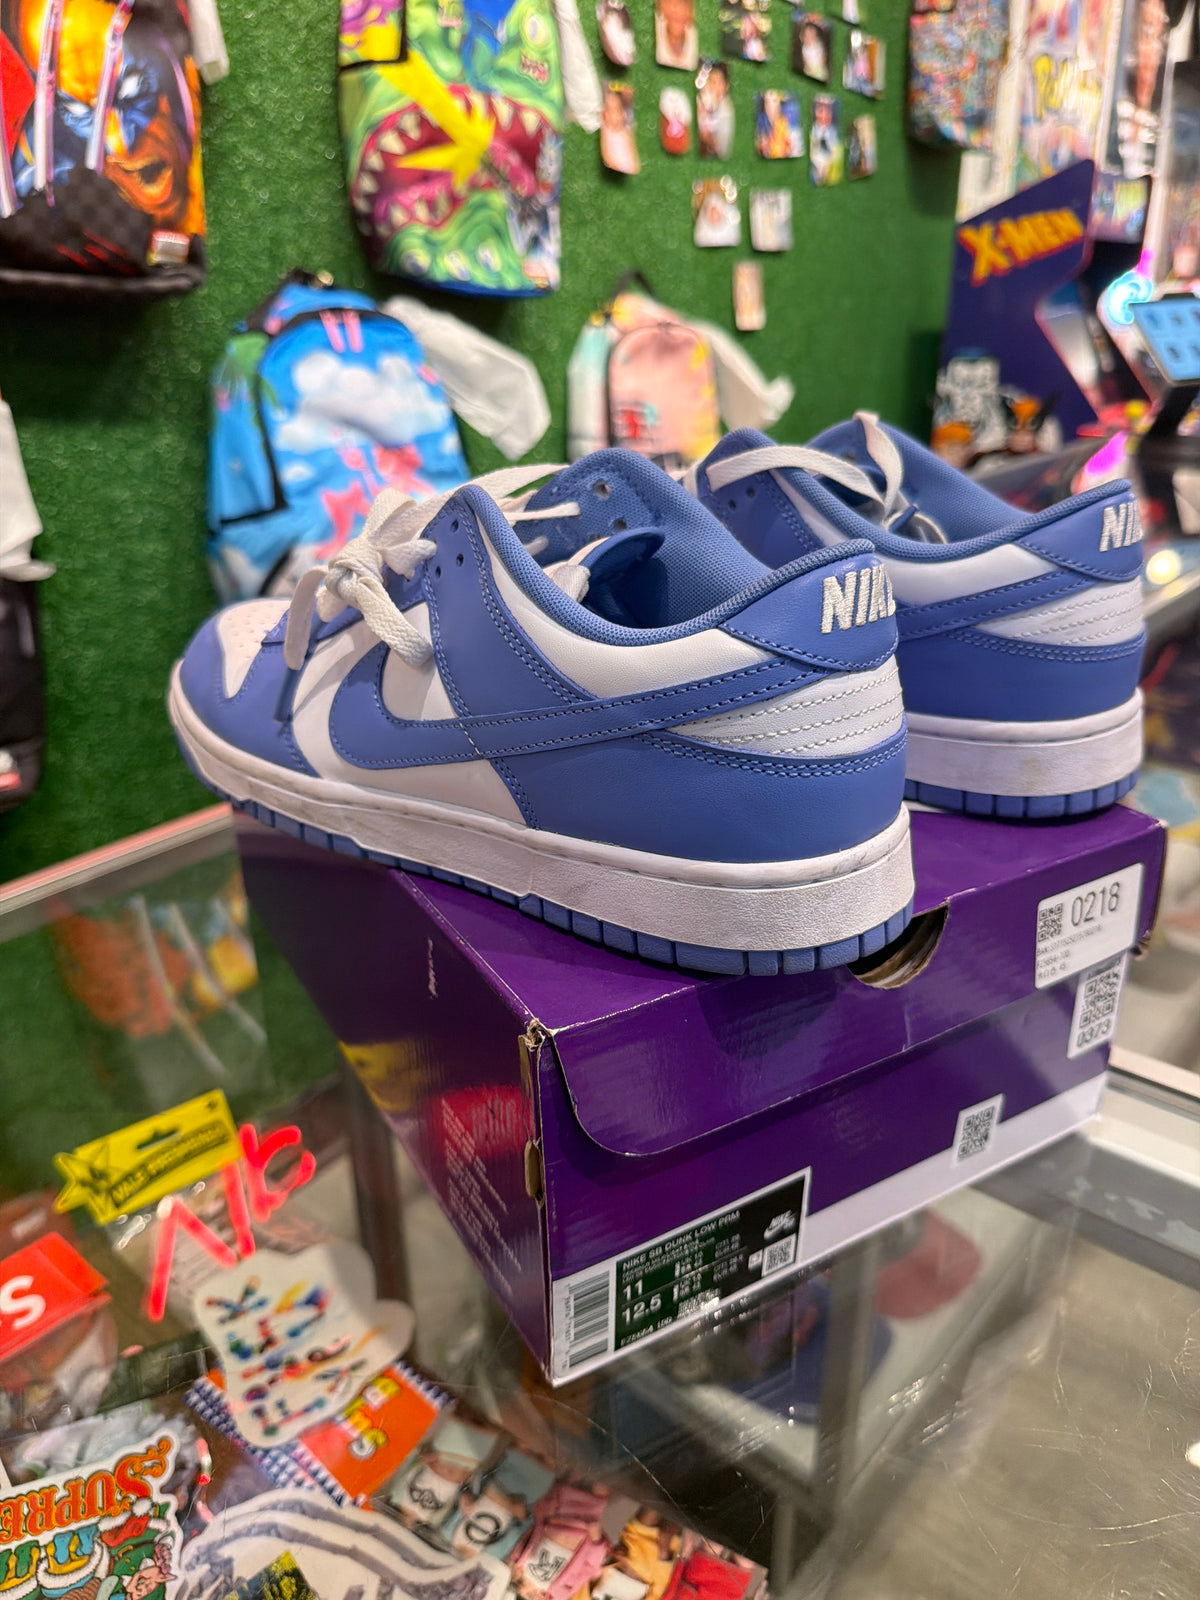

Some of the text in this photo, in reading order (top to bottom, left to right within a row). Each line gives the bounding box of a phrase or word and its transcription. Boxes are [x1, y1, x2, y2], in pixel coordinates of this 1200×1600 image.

[957, 208, 1084, 286] X-MEN
[1071, 881, 1120, 928] 0218
[623, 1252, 647, 1271] NIKE
[649, 1246, 662, 1260] SB
[665, 1232, 692, 1253] DUNK
[695, 1221, 717, 1239] LOW
[622, 1293, 662, 1325] 12.5
[623, 1280, 643, 1301] 11
